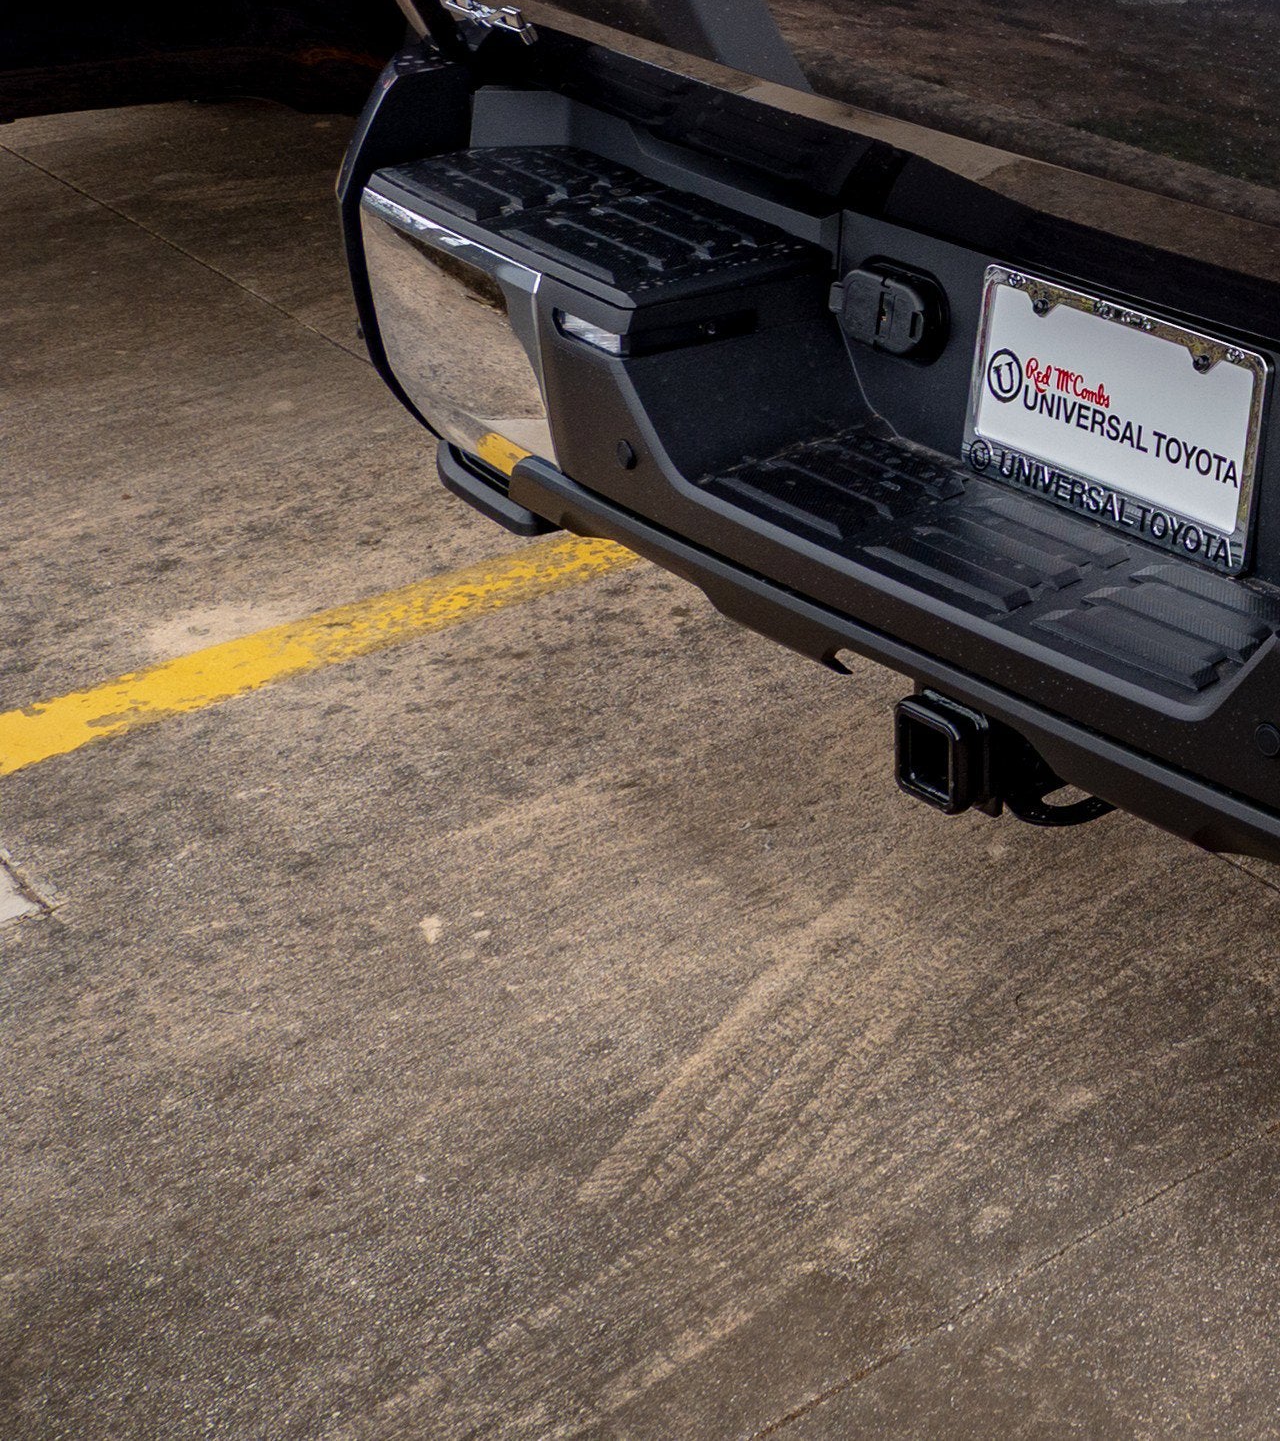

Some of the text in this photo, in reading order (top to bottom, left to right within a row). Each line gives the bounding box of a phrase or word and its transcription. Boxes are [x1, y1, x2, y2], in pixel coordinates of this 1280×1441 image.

[1026, 358, 1110, 408] Red McCombs
[1023, 384, 1239, 488] UNIVERSAL TOYOTA
[1000, 449, 1233, 567] UNIVERSAL TOYOTA
